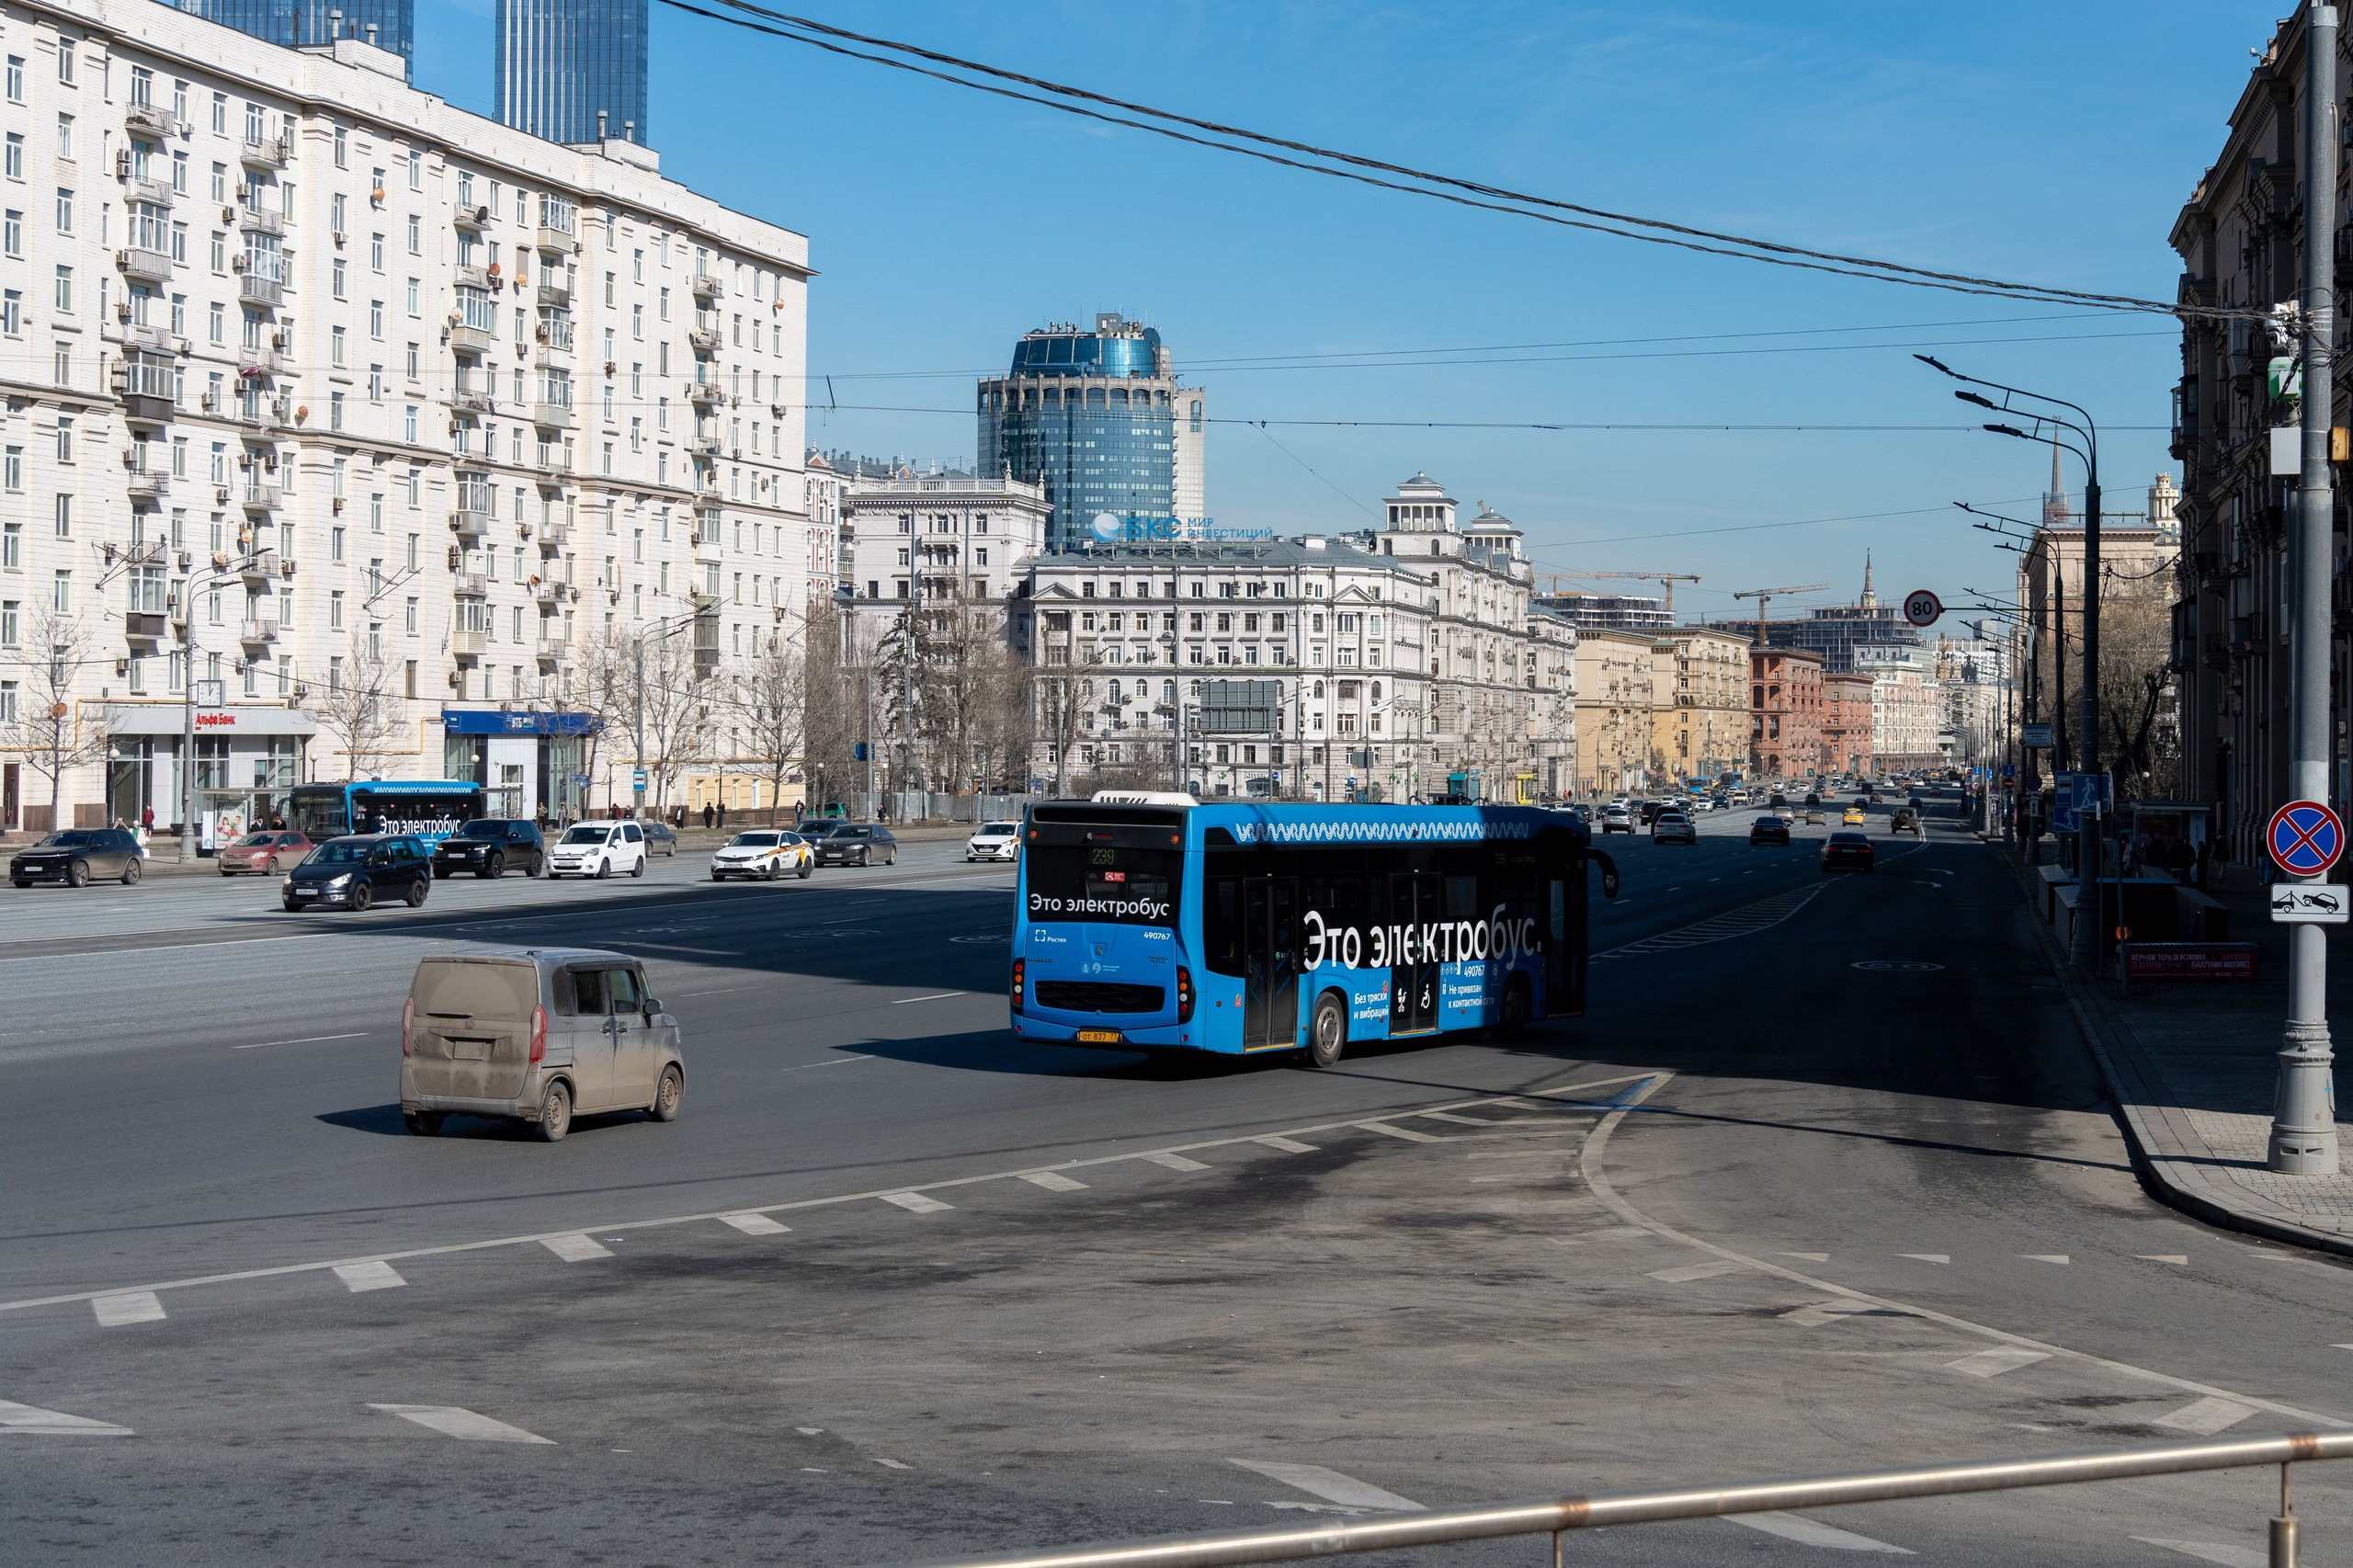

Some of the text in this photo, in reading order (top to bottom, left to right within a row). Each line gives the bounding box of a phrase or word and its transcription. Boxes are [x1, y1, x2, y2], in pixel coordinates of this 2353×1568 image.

[1126, 517, 1182, 539] БКС
[1188, 517, 1213, 527] МИР
[1188, 527, 1273, 540] ИНВЕСТИЦИЙ
[1912, 600, 1933, 616] 80
[195, 712, 235, 728] Альфа Банк
[511, 717, 523, 728] ВТБ
[379, 813, 461, 839] Это электробус
[1092, 848, 1115, 865] 239
[1029, 893, 1170, 919] Это электробус
[1143, 931, 1171, 940] 490767
[1303, 910, 1361, 971] Это
[2131, 953, 2155, 961] ВЕРНЕМ
[2156, 953, 2173, 961] 10%
[2191, 960, 2222, 969] БАЛЛАМИ
[1463, 965, 1485, 978] 490767
[1449, 984, 1483, 996] Не привязан
[1354, 992, 1388, 1005] Без тряски
[1452, 996, 1483, 1007] контактной
[1483, 996, 1495, 1006] сети
[1359, 1006, 1389, 1020] вибраций
[1093, 1032, 1107, 1040] 837
